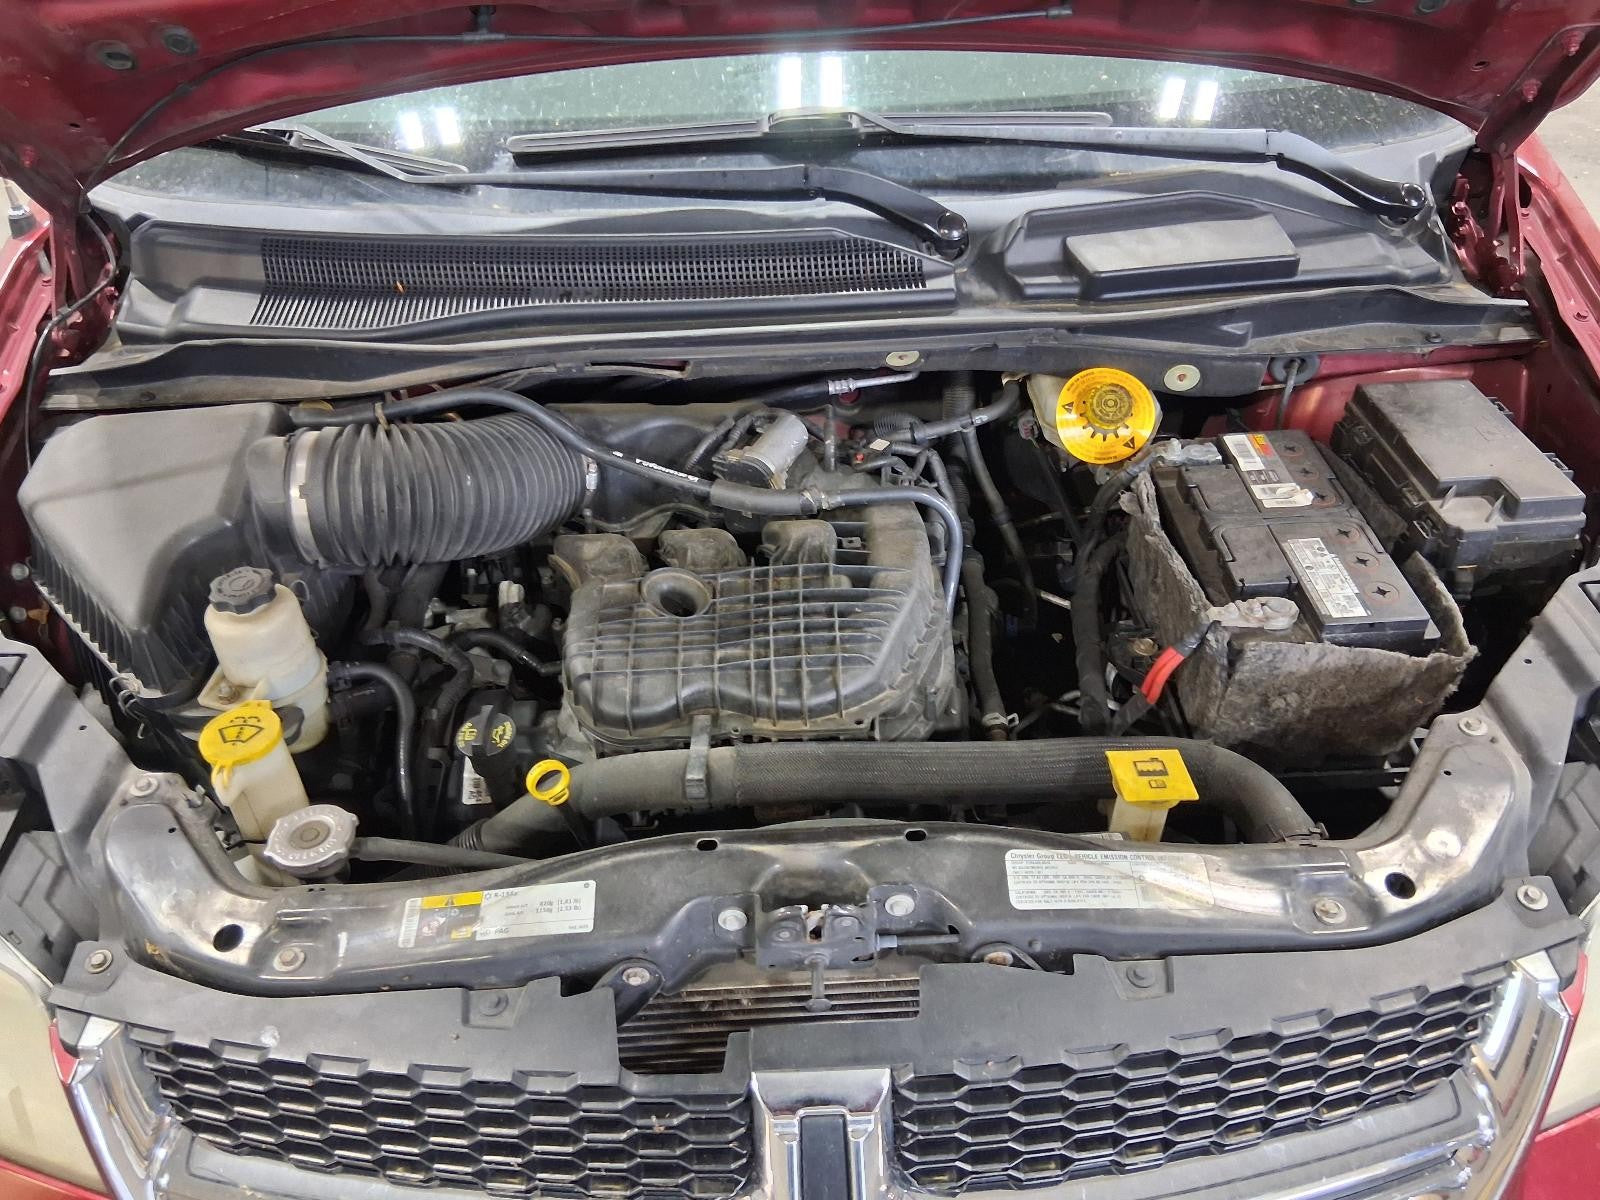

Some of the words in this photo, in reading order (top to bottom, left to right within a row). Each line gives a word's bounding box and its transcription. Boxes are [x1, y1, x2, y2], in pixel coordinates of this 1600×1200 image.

[1010, 853, 1035, 861] Chrysler
[1036, 852, 1055, 861] Group
[1100, 853, 1128, 861] EMISSION
